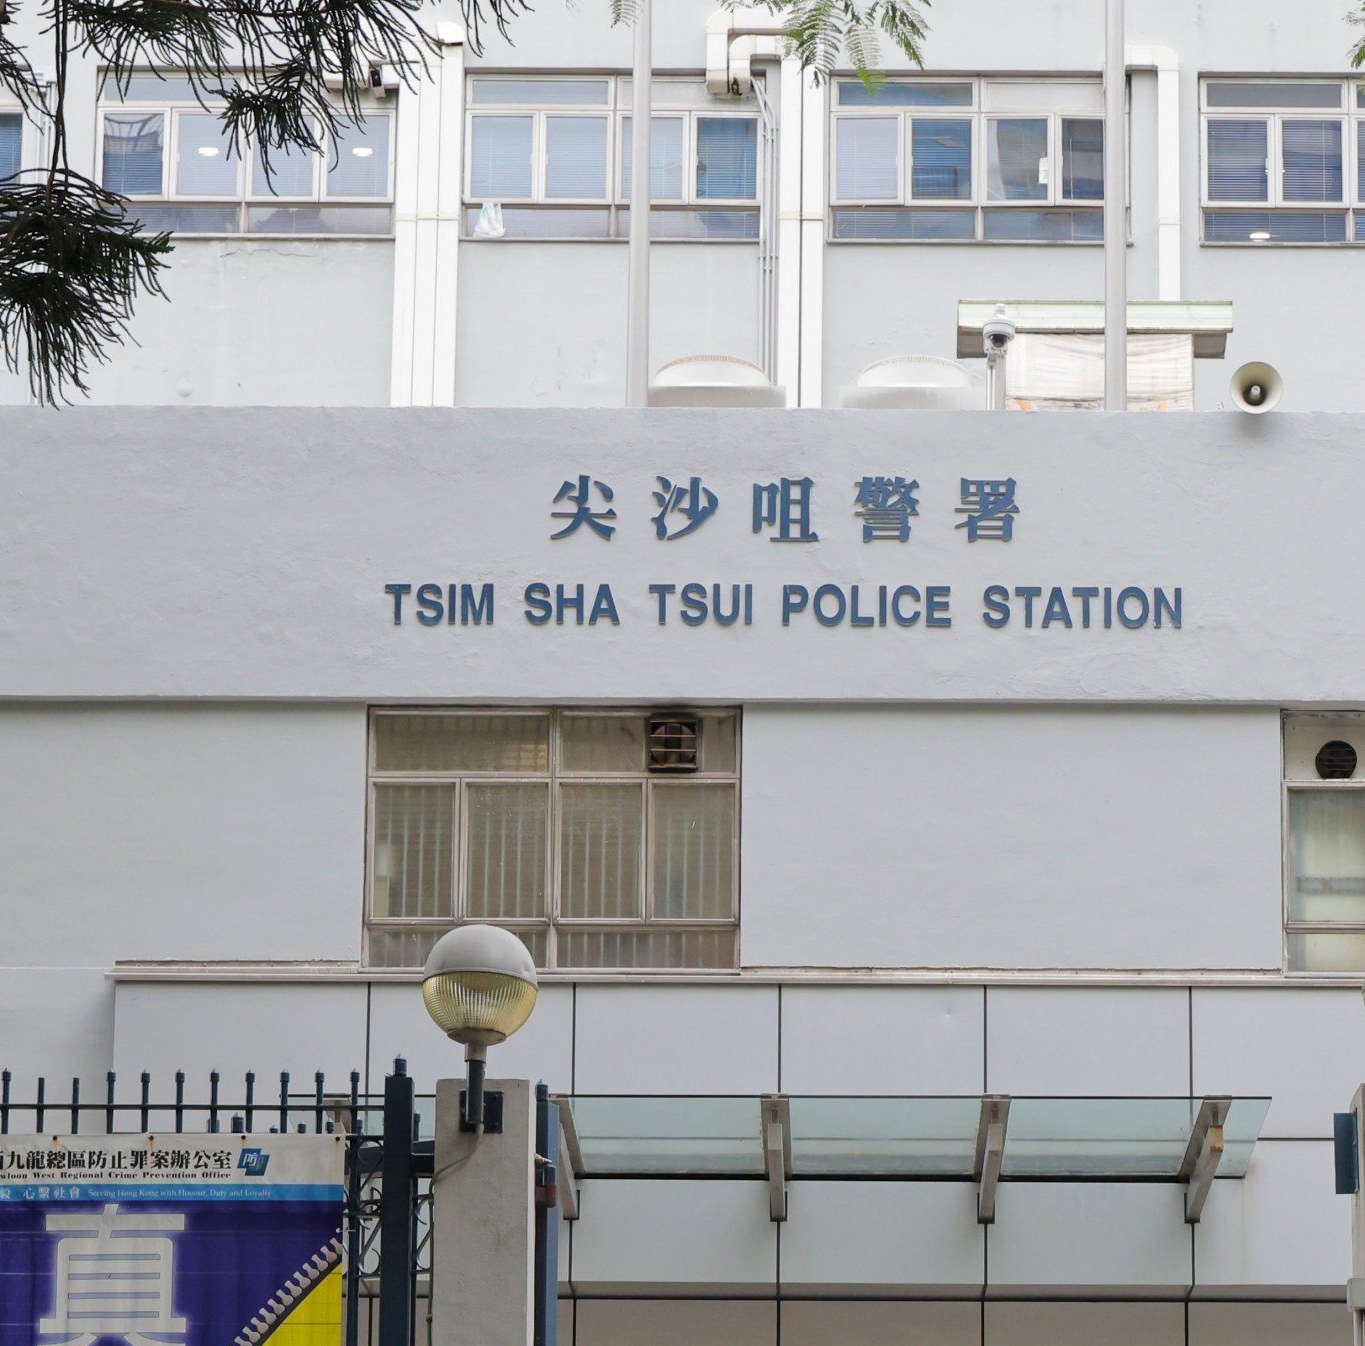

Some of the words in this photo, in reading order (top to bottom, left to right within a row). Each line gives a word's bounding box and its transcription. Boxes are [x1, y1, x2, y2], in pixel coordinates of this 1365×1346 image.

[549, 474, 1021, 545] 尖沙咀警署
[384, 582, 494, 627] TSIM
[523, 582, 620, 627] SHA
[648, 583, 754, 627] TSUI
[782, 584, 952, 629] POLICE
[982, 584, 1183, 630] STATION
[32, 1171, 56, 1180] West
[60, 1171, 104, 1182] Regional
[108, 1171, 138, 1180] Crime
[142, 1171, 197, 1180] Prevention
[201, 1171, 232, 1180] Office
[88, 1187, 115, 1200] Serving
[117, 1187, 136, 1200] Hong
[138, 1187, 159, 1200] Kong
[160, 1187, 177, 1200] with
[210, 1187, 228, 1200] Duty
[228, 1187, 244, 1200] and
[245, 1187, 272, 1200] Loyalty
